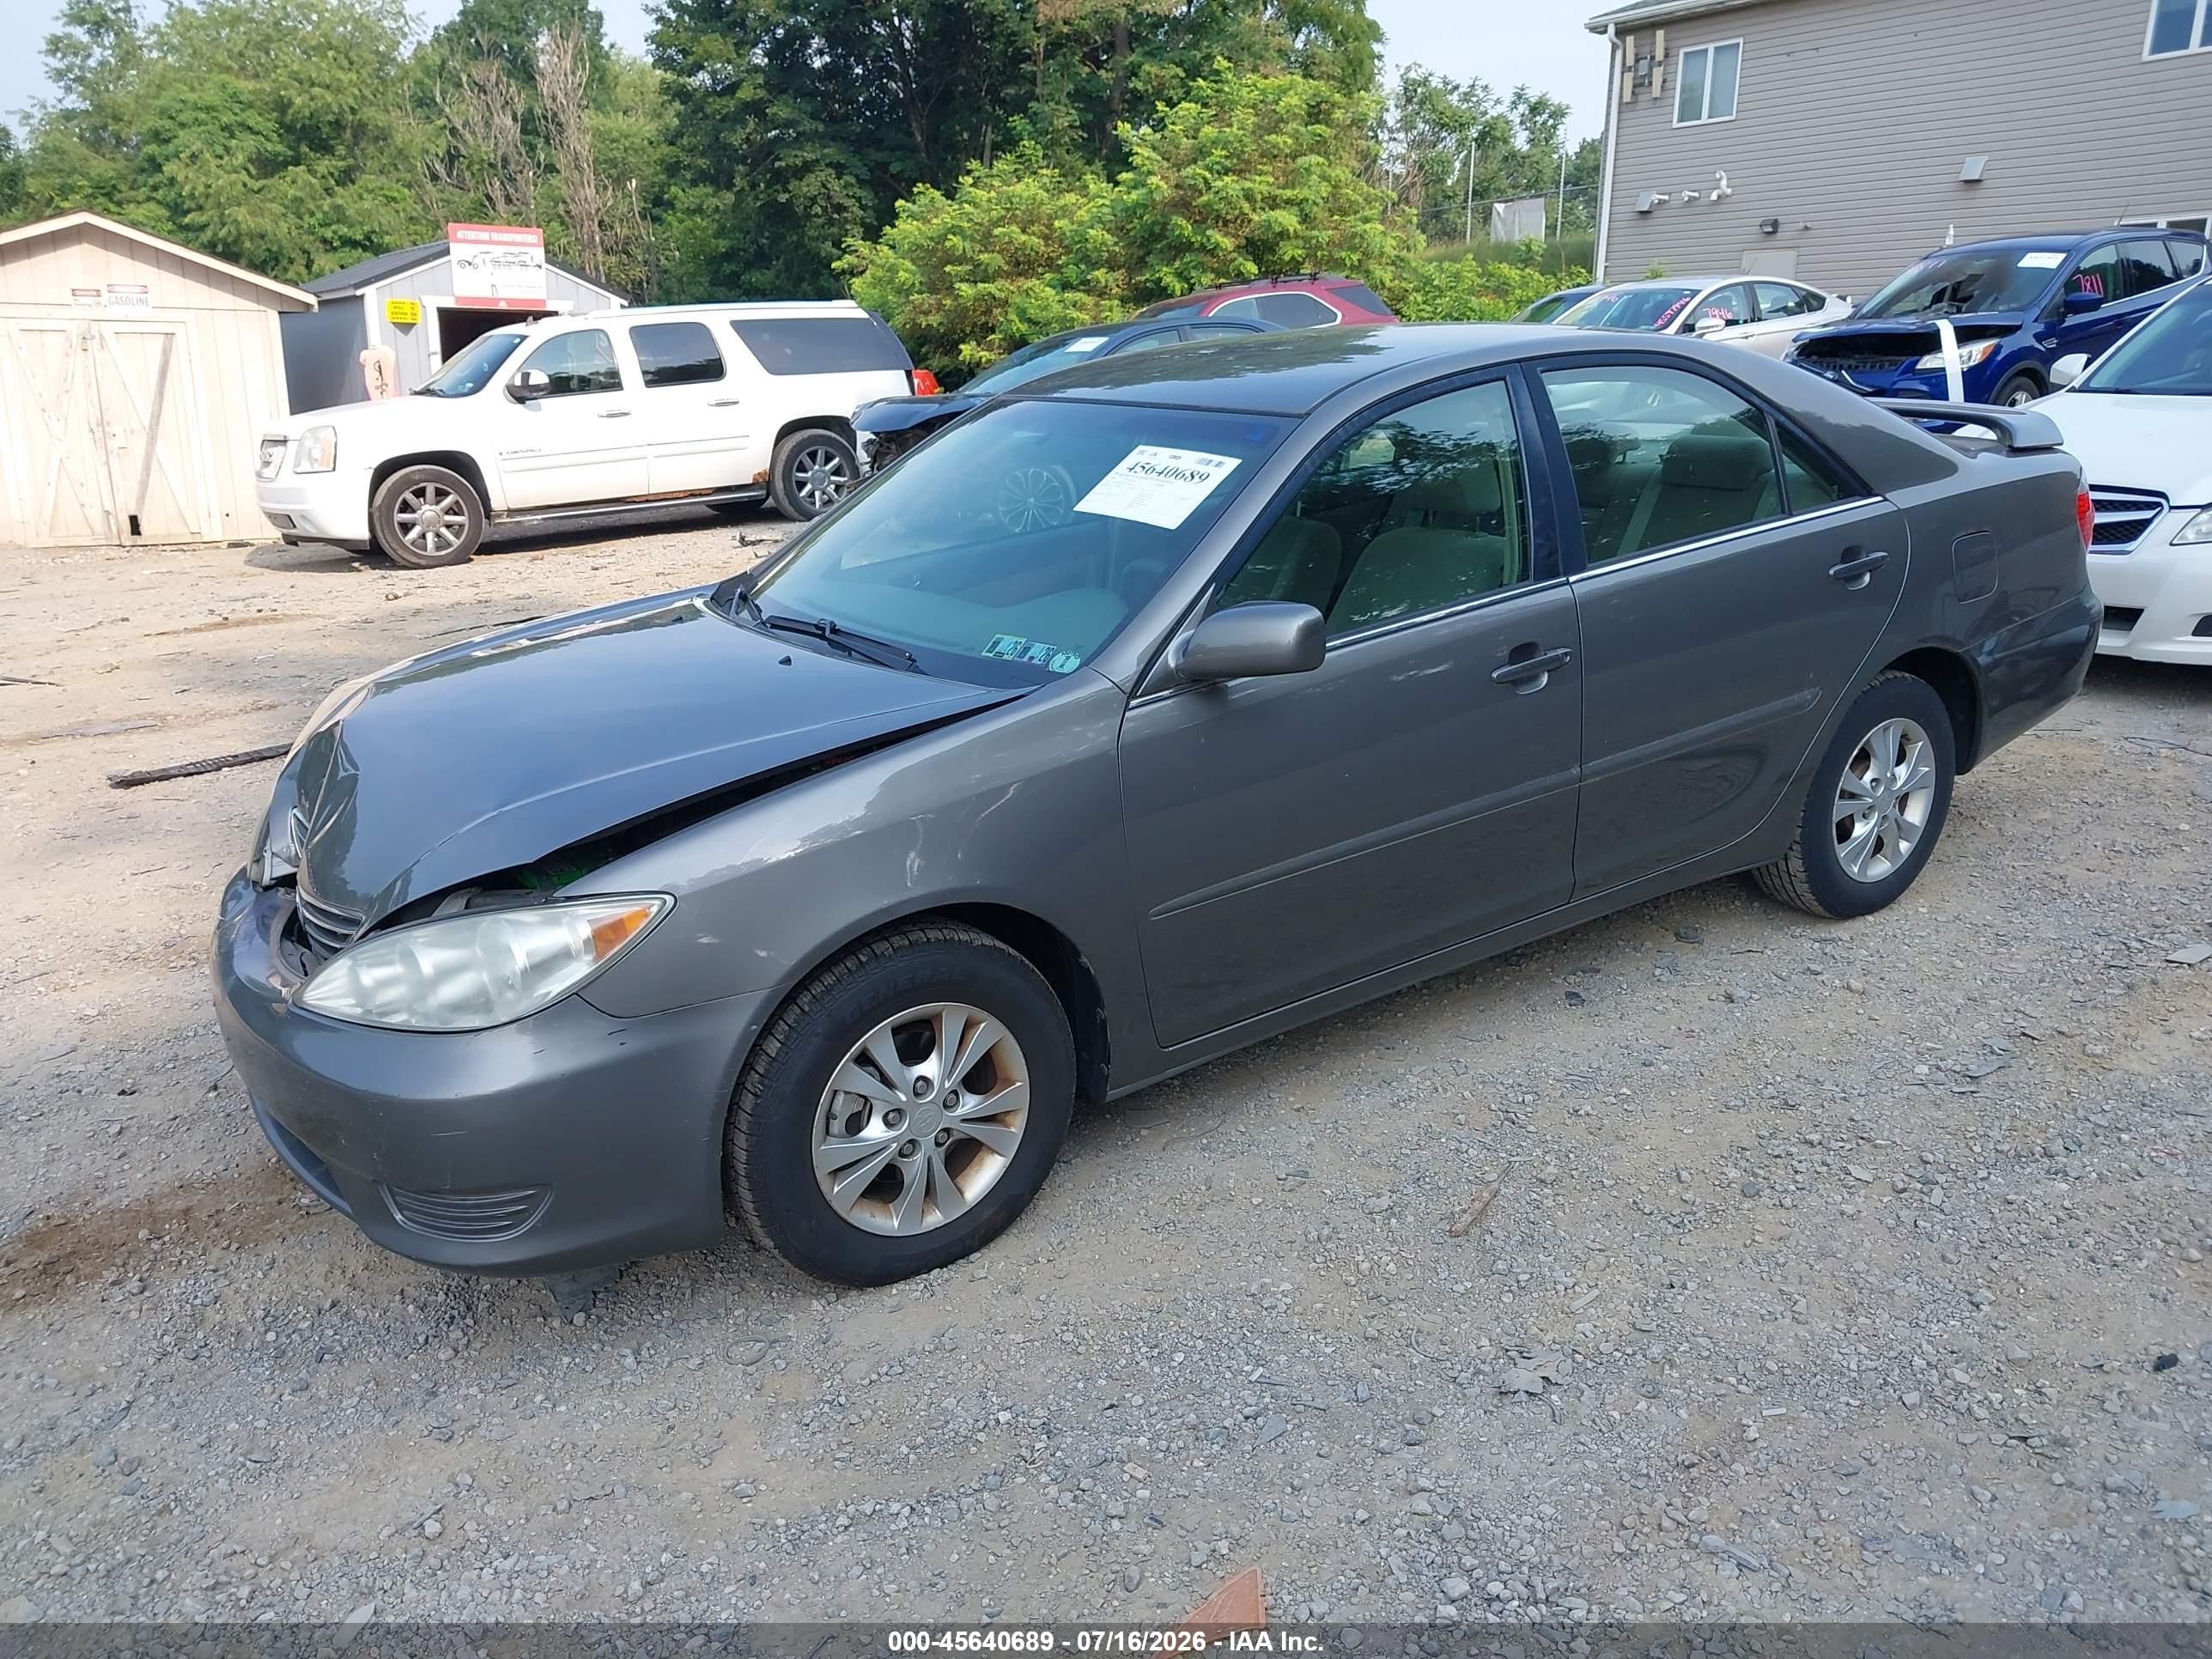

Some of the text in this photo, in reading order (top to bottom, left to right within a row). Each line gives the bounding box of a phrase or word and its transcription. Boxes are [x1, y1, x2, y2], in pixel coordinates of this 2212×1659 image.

[108, 295, 149, 307] GASOLINE
[1703, 307, 1733, 319] 7946
[1126, 460, 1211, 484] 45640689
